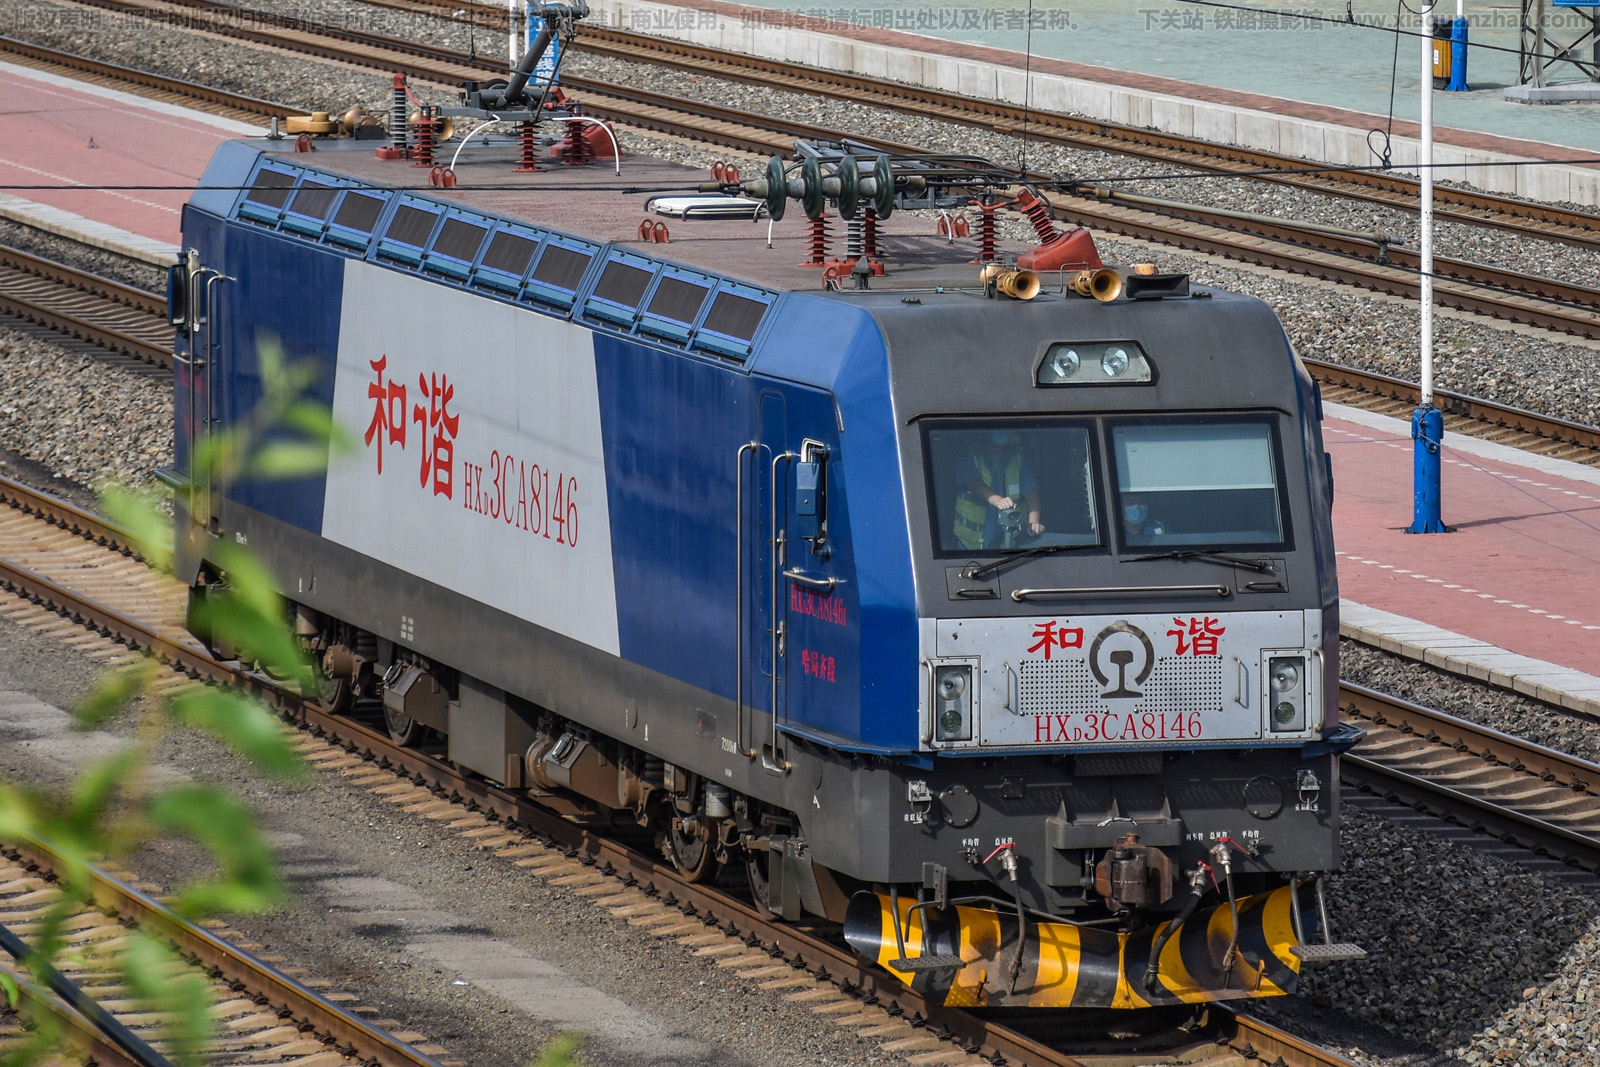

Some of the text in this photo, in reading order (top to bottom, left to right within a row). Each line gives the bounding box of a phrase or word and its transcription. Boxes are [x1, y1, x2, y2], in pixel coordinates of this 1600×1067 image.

[364, 354, 578, 548] 和谐 HXD3CA8146
[1027, 616, 1226, 660] 和 谐
[1034, 711, 1202, 743] HXD3CA8146
